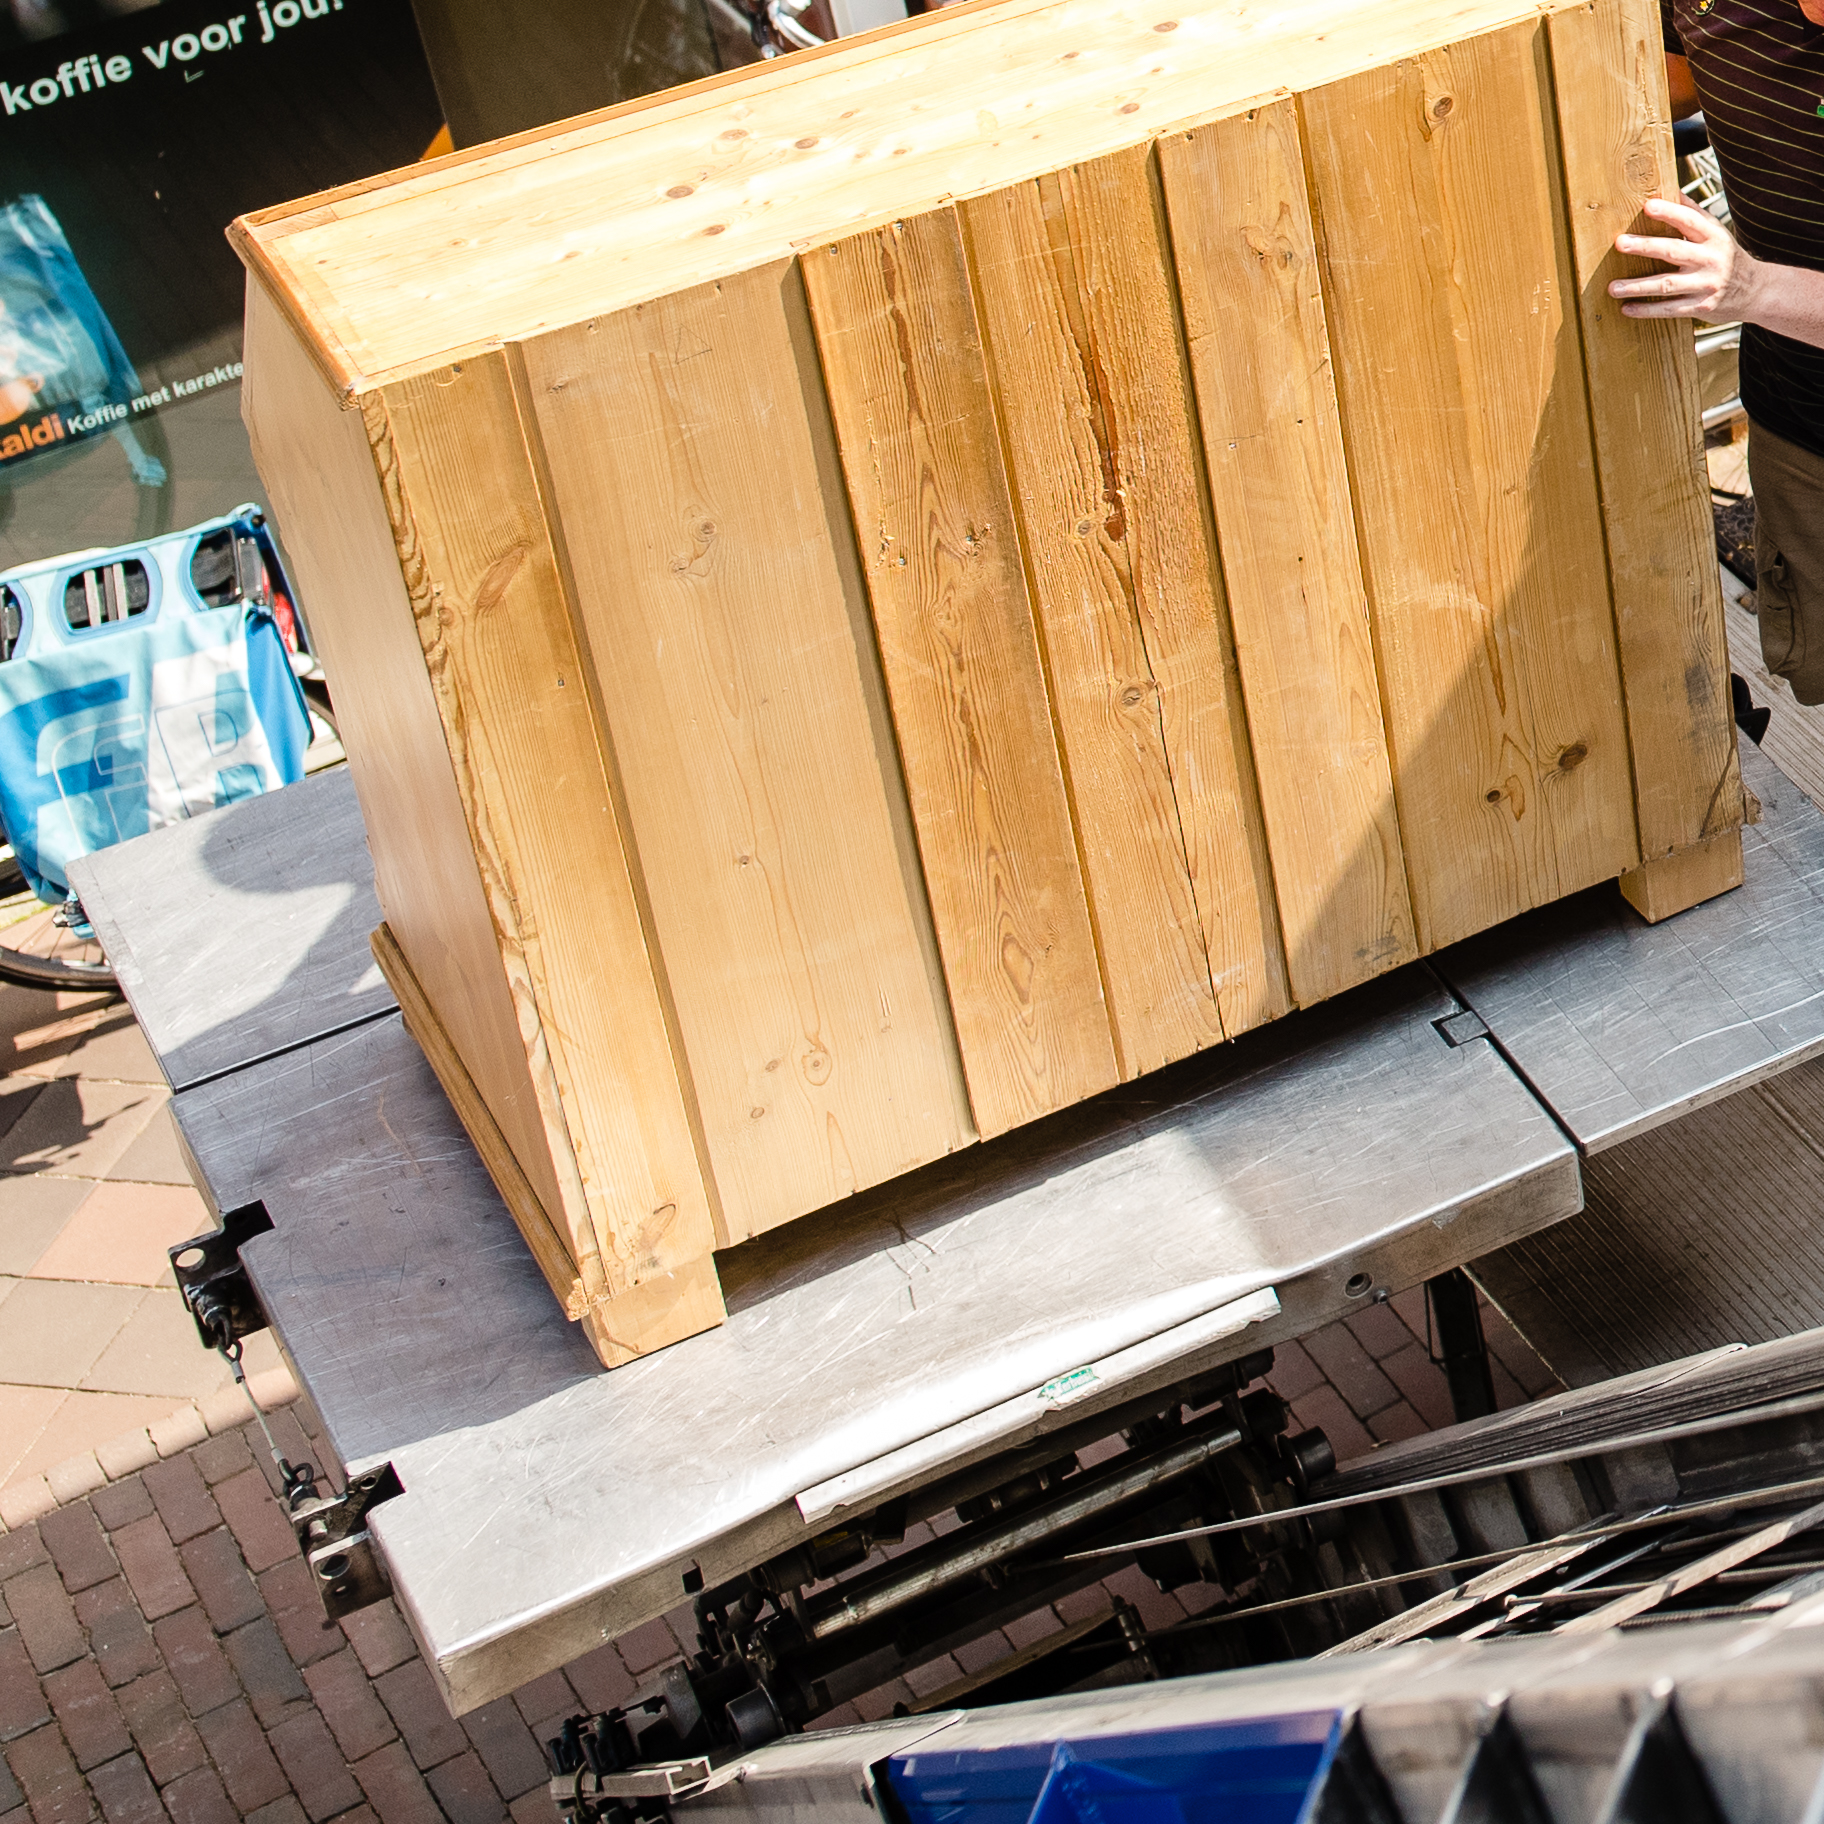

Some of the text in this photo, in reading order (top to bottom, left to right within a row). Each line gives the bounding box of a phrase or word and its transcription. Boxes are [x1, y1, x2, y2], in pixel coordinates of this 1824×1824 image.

[0, 52, 133, 115] koffie
[141, 14, 247, 72] voor
[0, 360, 244, 461] aldi Koffie met karakte
